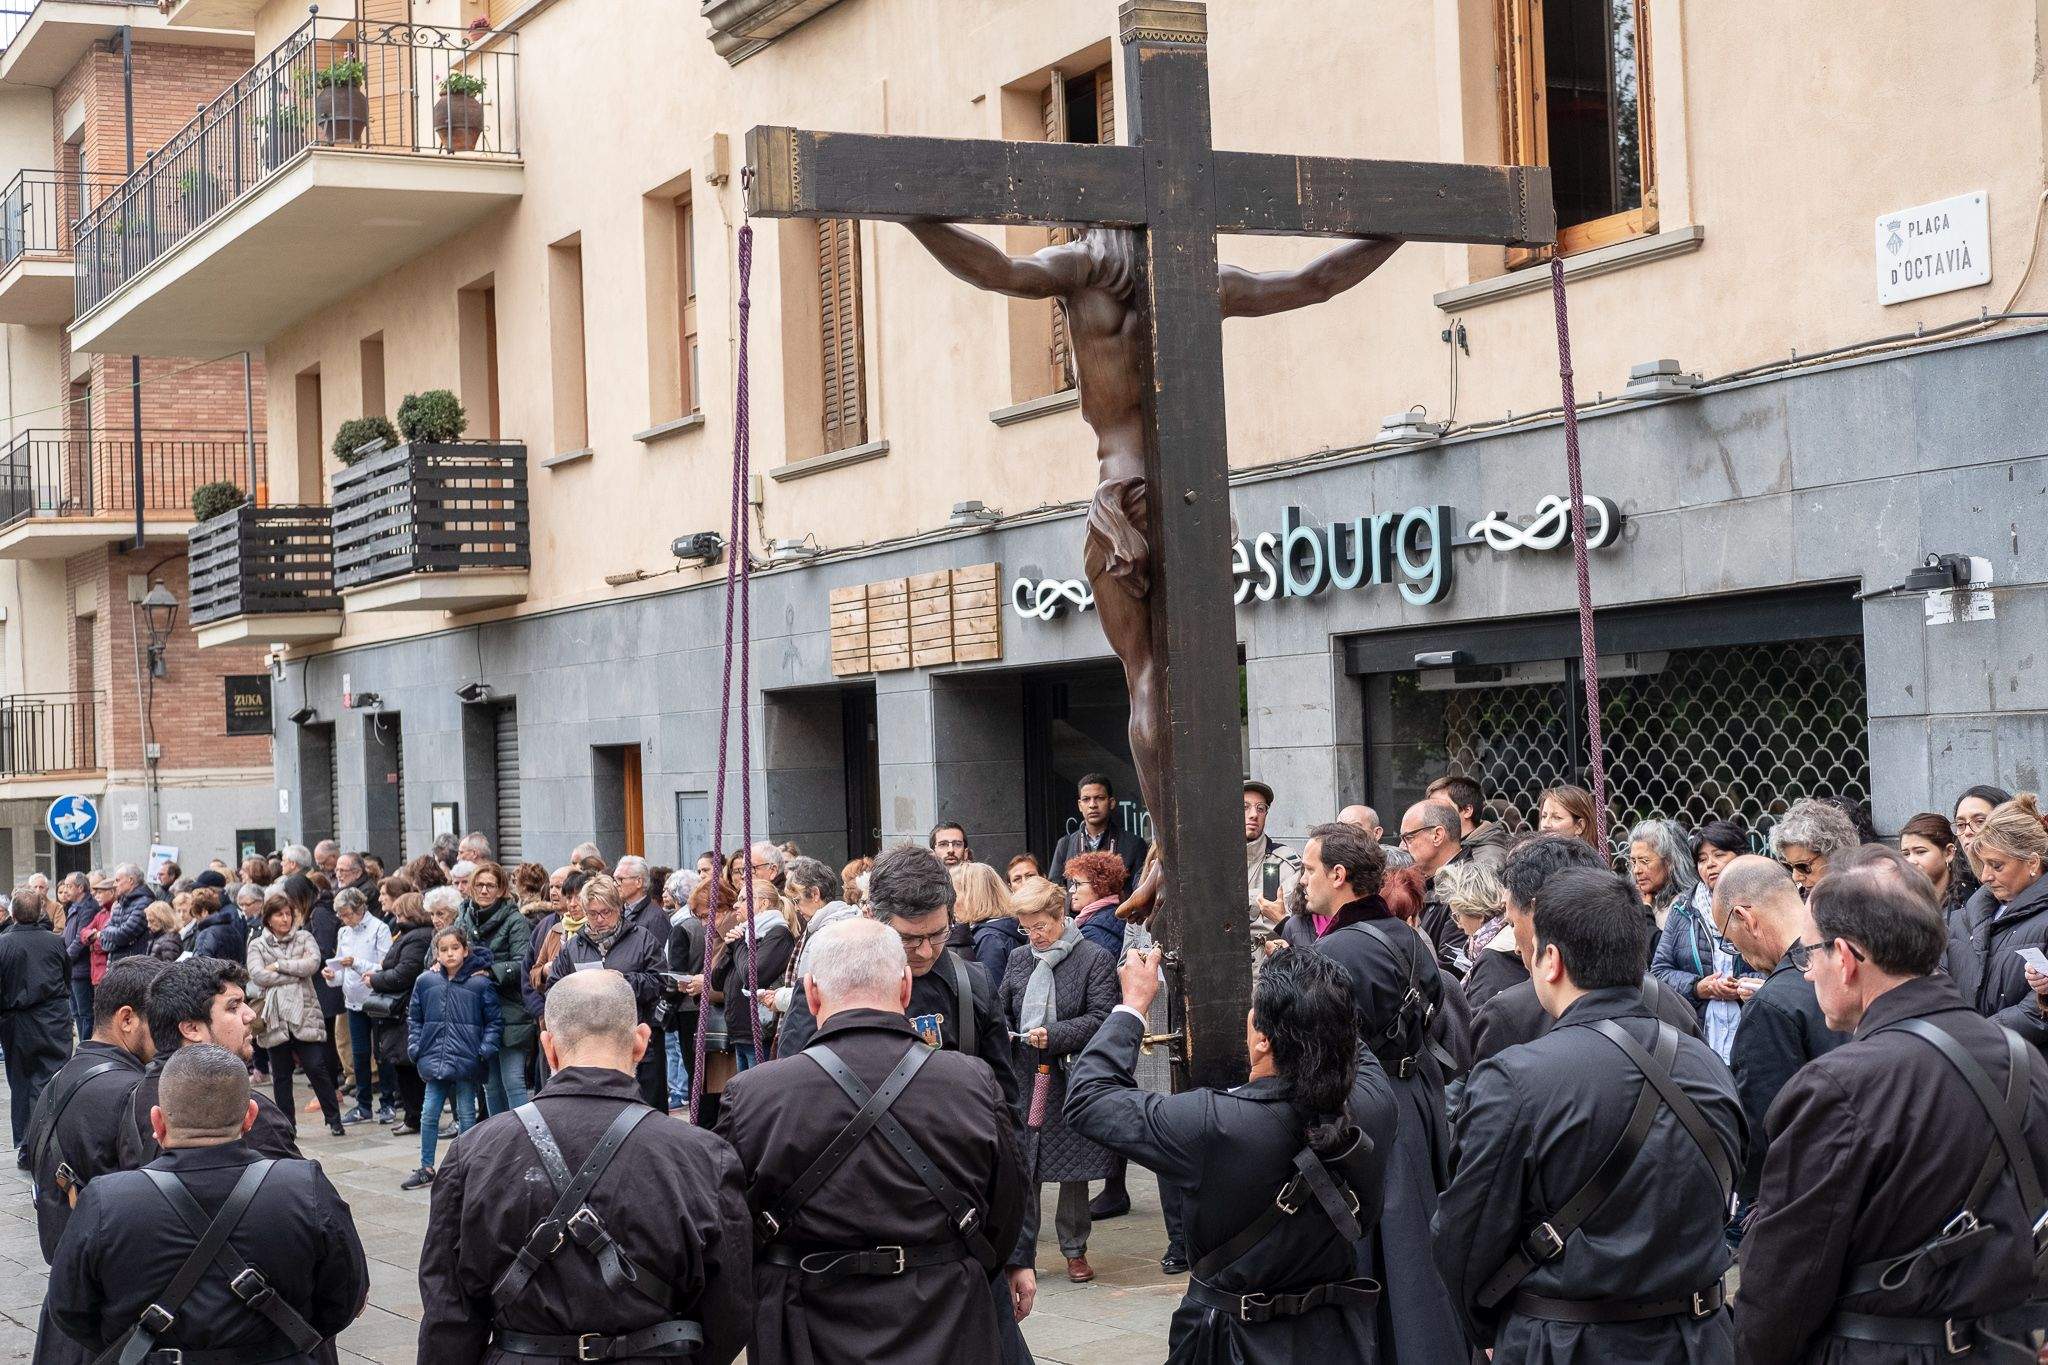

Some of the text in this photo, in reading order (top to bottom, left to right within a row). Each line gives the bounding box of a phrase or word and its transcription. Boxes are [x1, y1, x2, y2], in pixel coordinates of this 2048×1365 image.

[1908, 213, 1950, 238] PLAÇA
[1891, 240, 1972, 285] D'OCTAVIÀ
[1232, 505, 1450, 606] esburg
[234, 693, 264, 707] ZUKA
